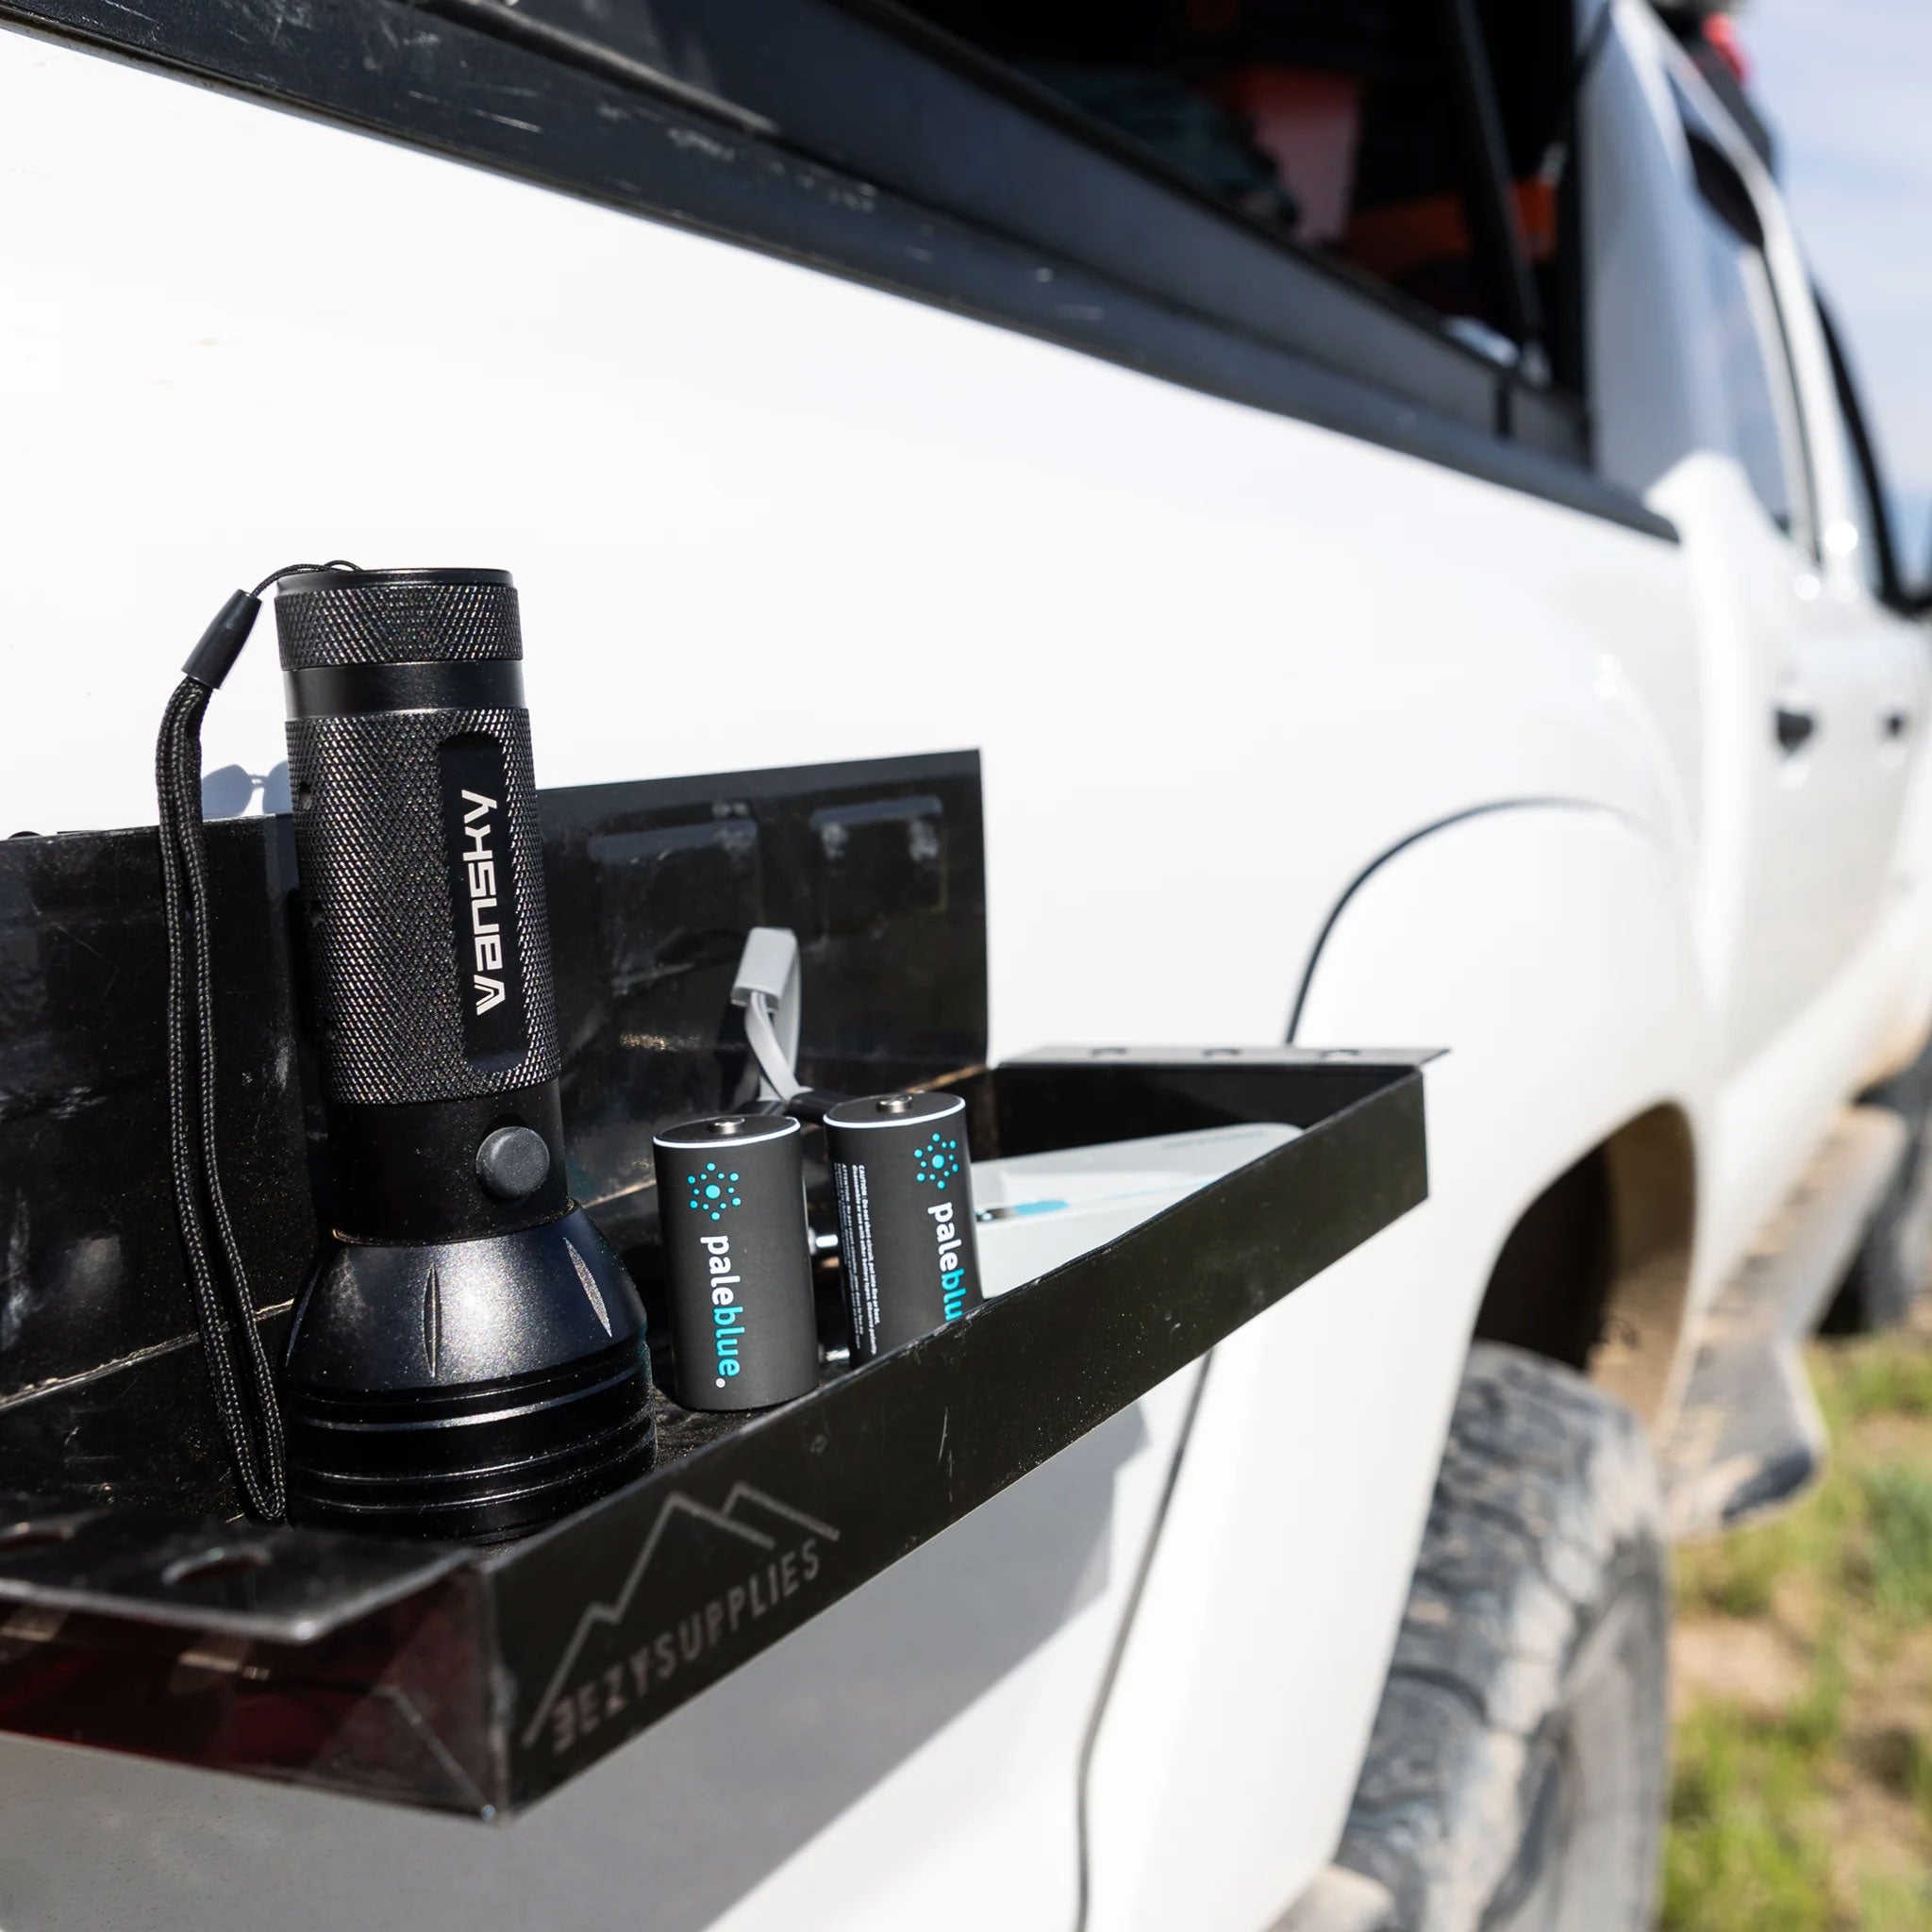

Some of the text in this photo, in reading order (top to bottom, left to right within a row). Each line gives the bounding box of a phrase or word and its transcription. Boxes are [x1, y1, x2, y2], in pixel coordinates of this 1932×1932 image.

[851, 1164, 861, 1204] disassemble
[856, 1204, 862, 1212] or
[861, 1198, 869, 1208] Do
[927, 1202, 966, 1321] paleblu
